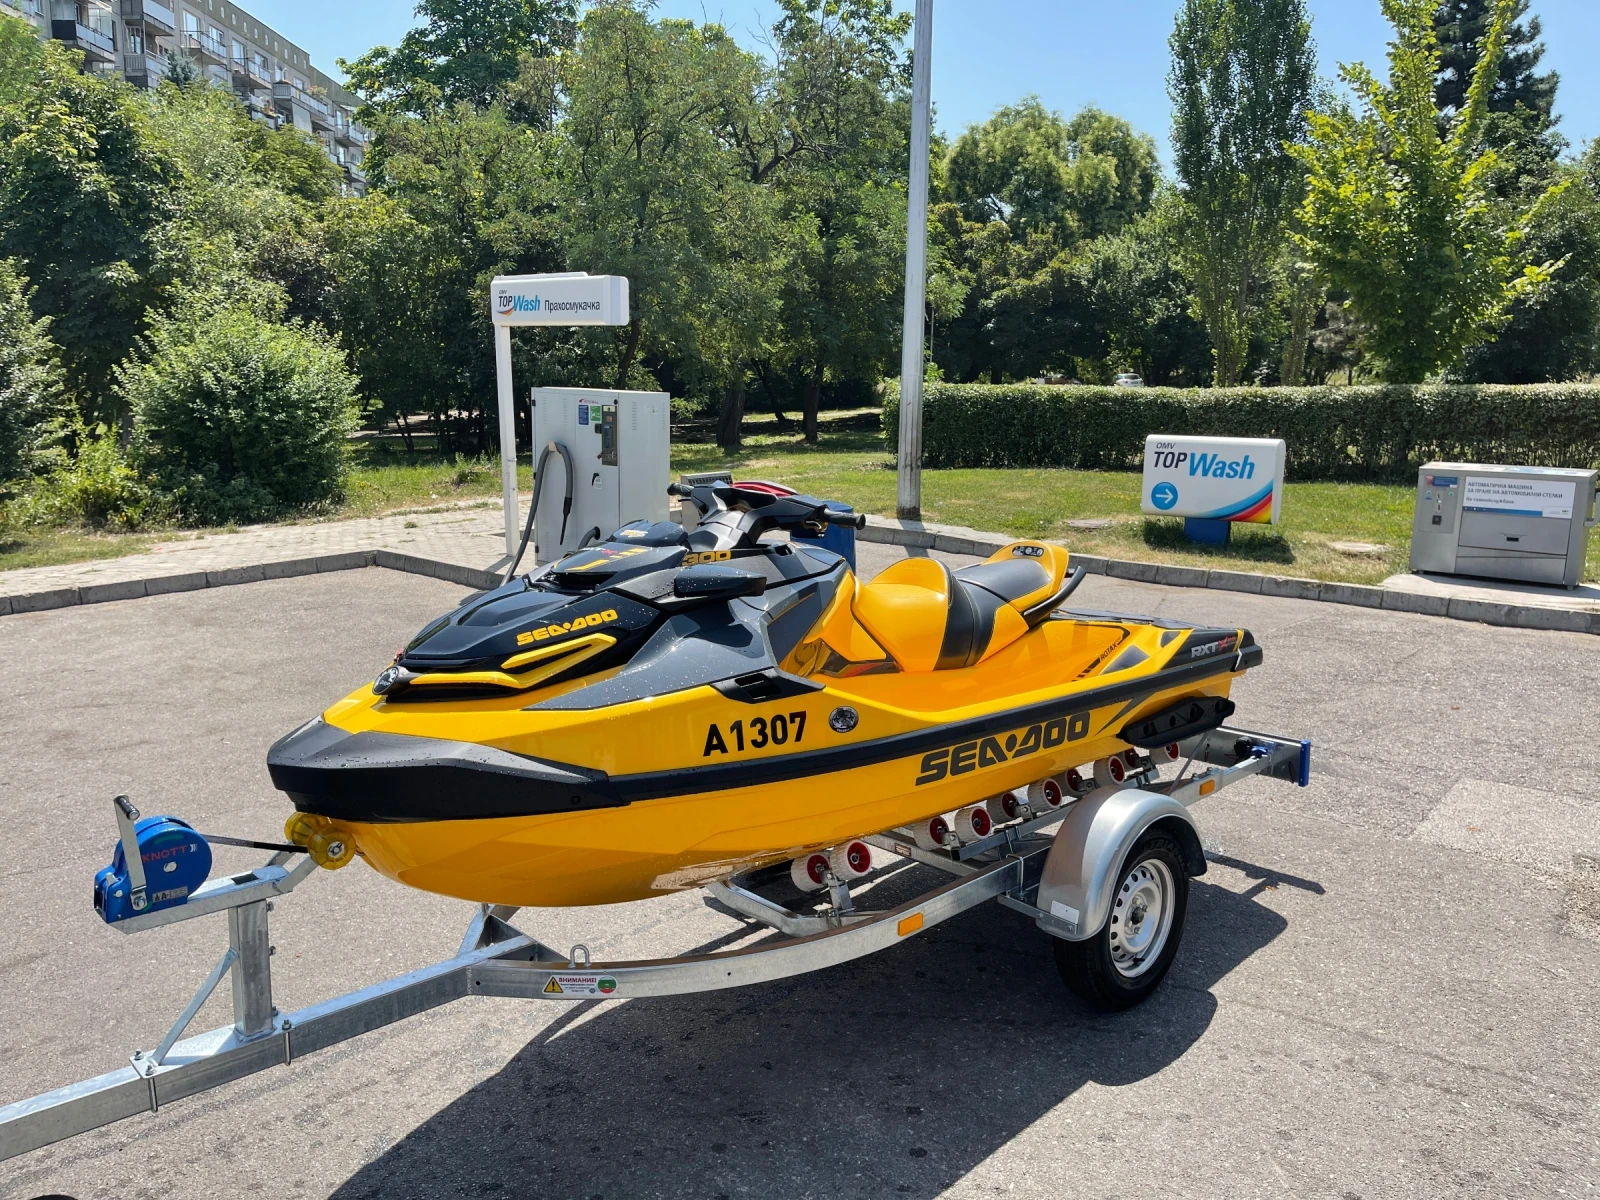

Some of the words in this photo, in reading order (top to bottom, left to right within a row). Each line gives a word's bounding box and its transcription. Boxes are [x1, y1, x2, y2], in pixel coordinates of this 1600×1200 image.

[544, 299, 600, 313] Прахосмукачка
[1156, 442, 1176, 450] OMV
[703, 710, 807, 757] A1307
[142, 845, 188, 862] KNOTT
